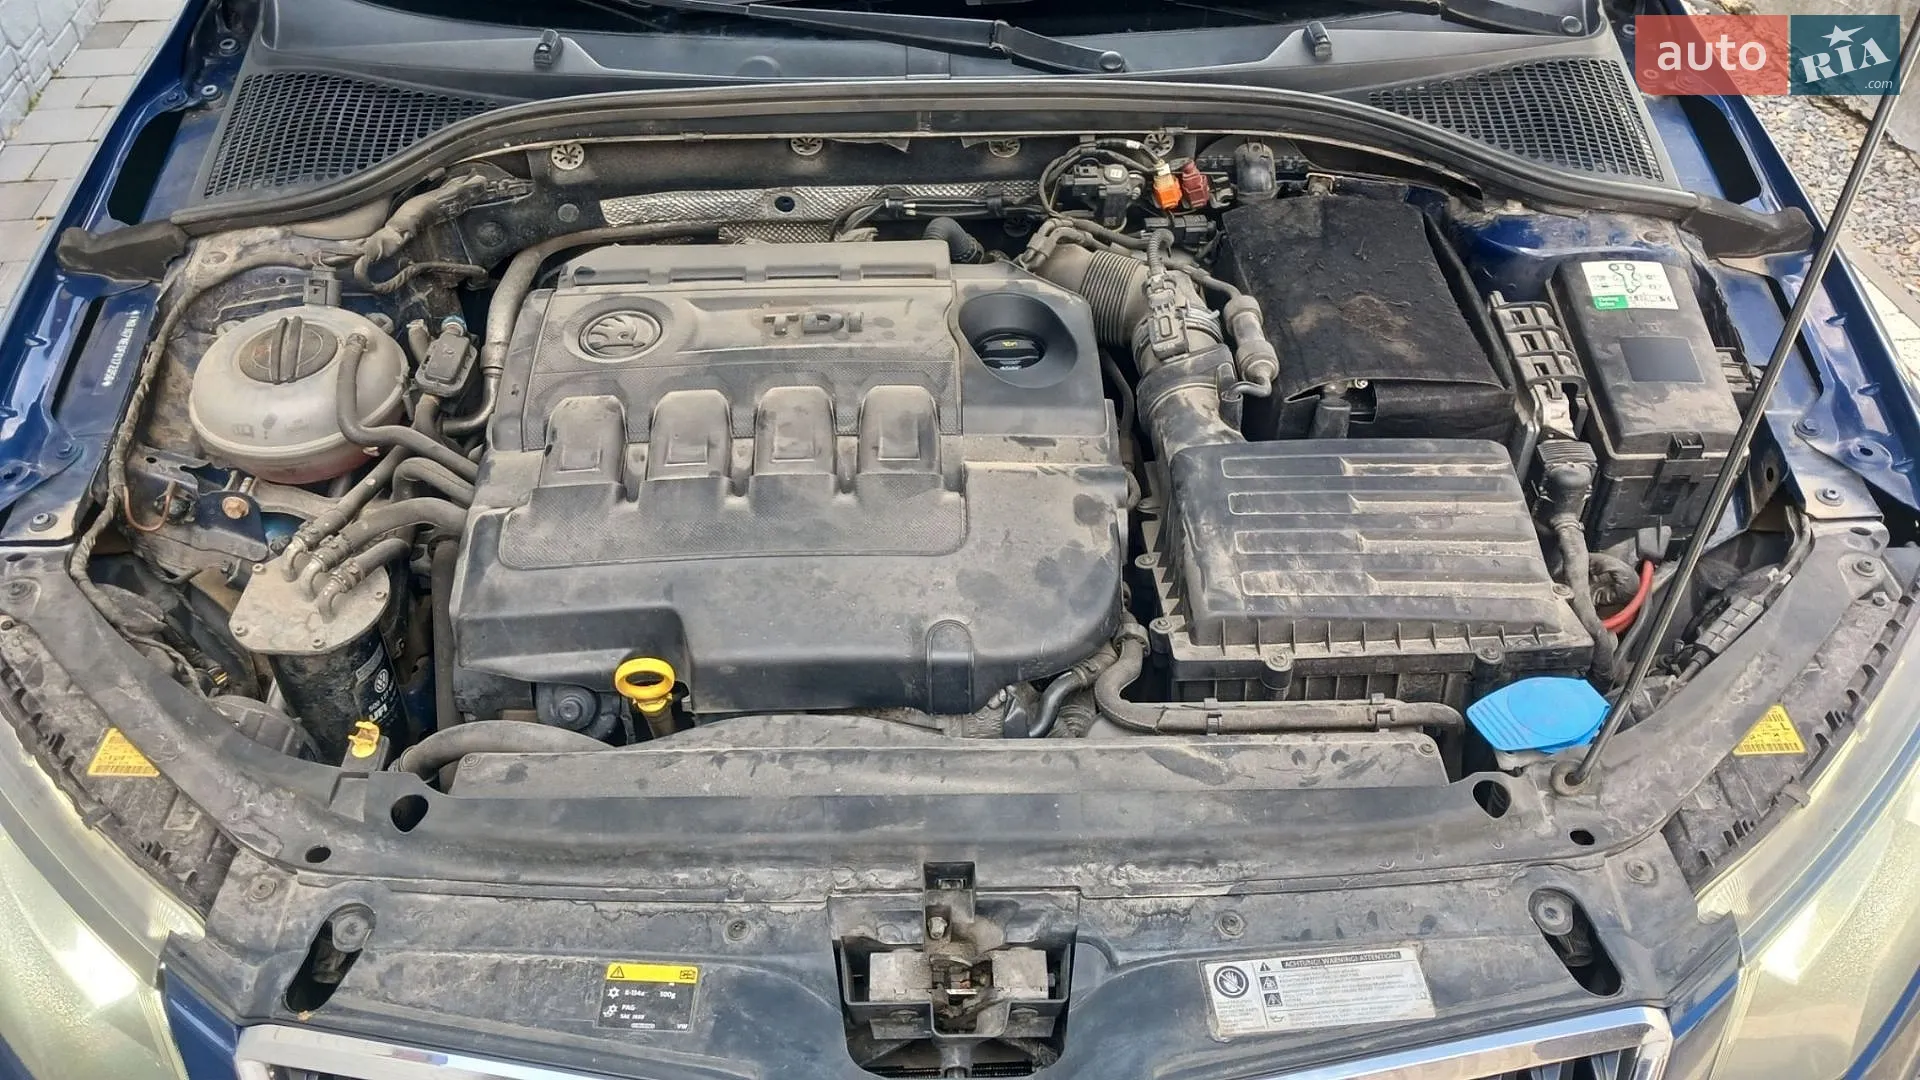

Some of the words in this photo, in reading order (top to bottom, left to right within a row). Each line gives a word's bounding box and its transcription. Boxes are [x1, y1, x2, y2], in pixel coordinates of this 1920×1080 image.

[763, 311, 864, 335] TDI
[1321, 954, 1358, 965] WARNING!
[1359, 951, 1400, 963] ATTENTION!
